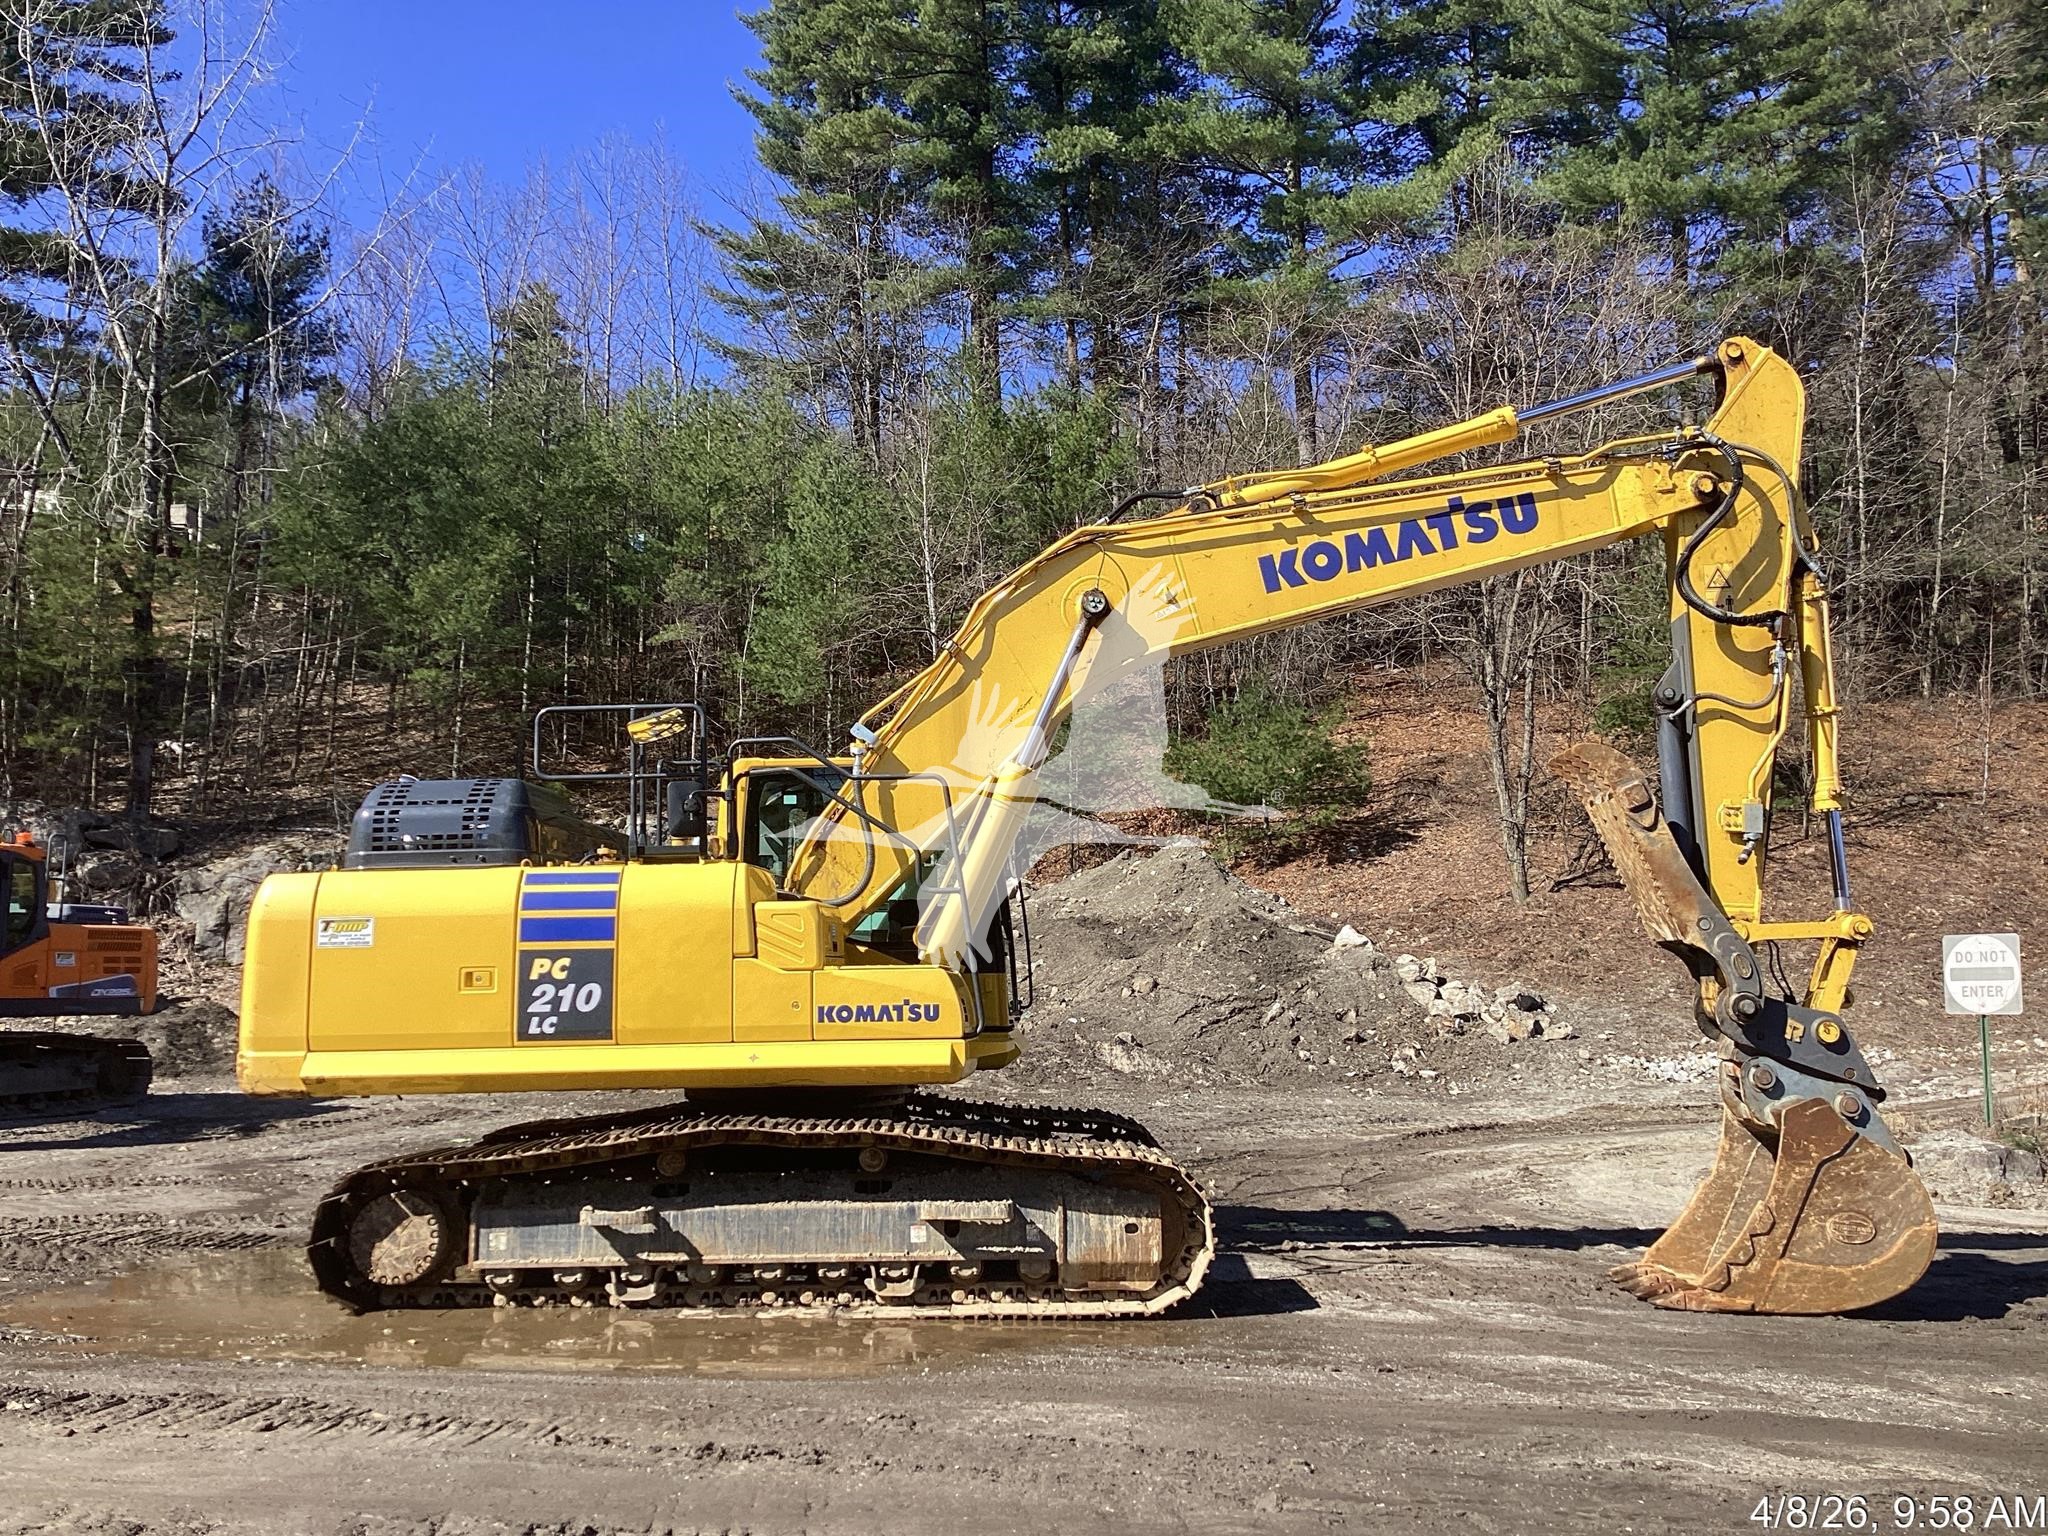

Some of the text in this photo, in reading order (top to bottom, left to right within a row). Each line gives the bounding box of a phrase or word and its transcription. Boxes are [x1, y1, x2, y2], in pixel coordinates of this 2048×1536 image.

[1257, 492, 1540, 595] KOMATSU
[1955, 950, 2007, 963] DO NOT
[529, 957, 572, 980] PC
[526, 982, 602, 1013] 210
[1961, 985, 2004, 998] ENTER
[817, 998, 940, 1023] KOMATSU
[527, 1016, 558, 1035] LC
